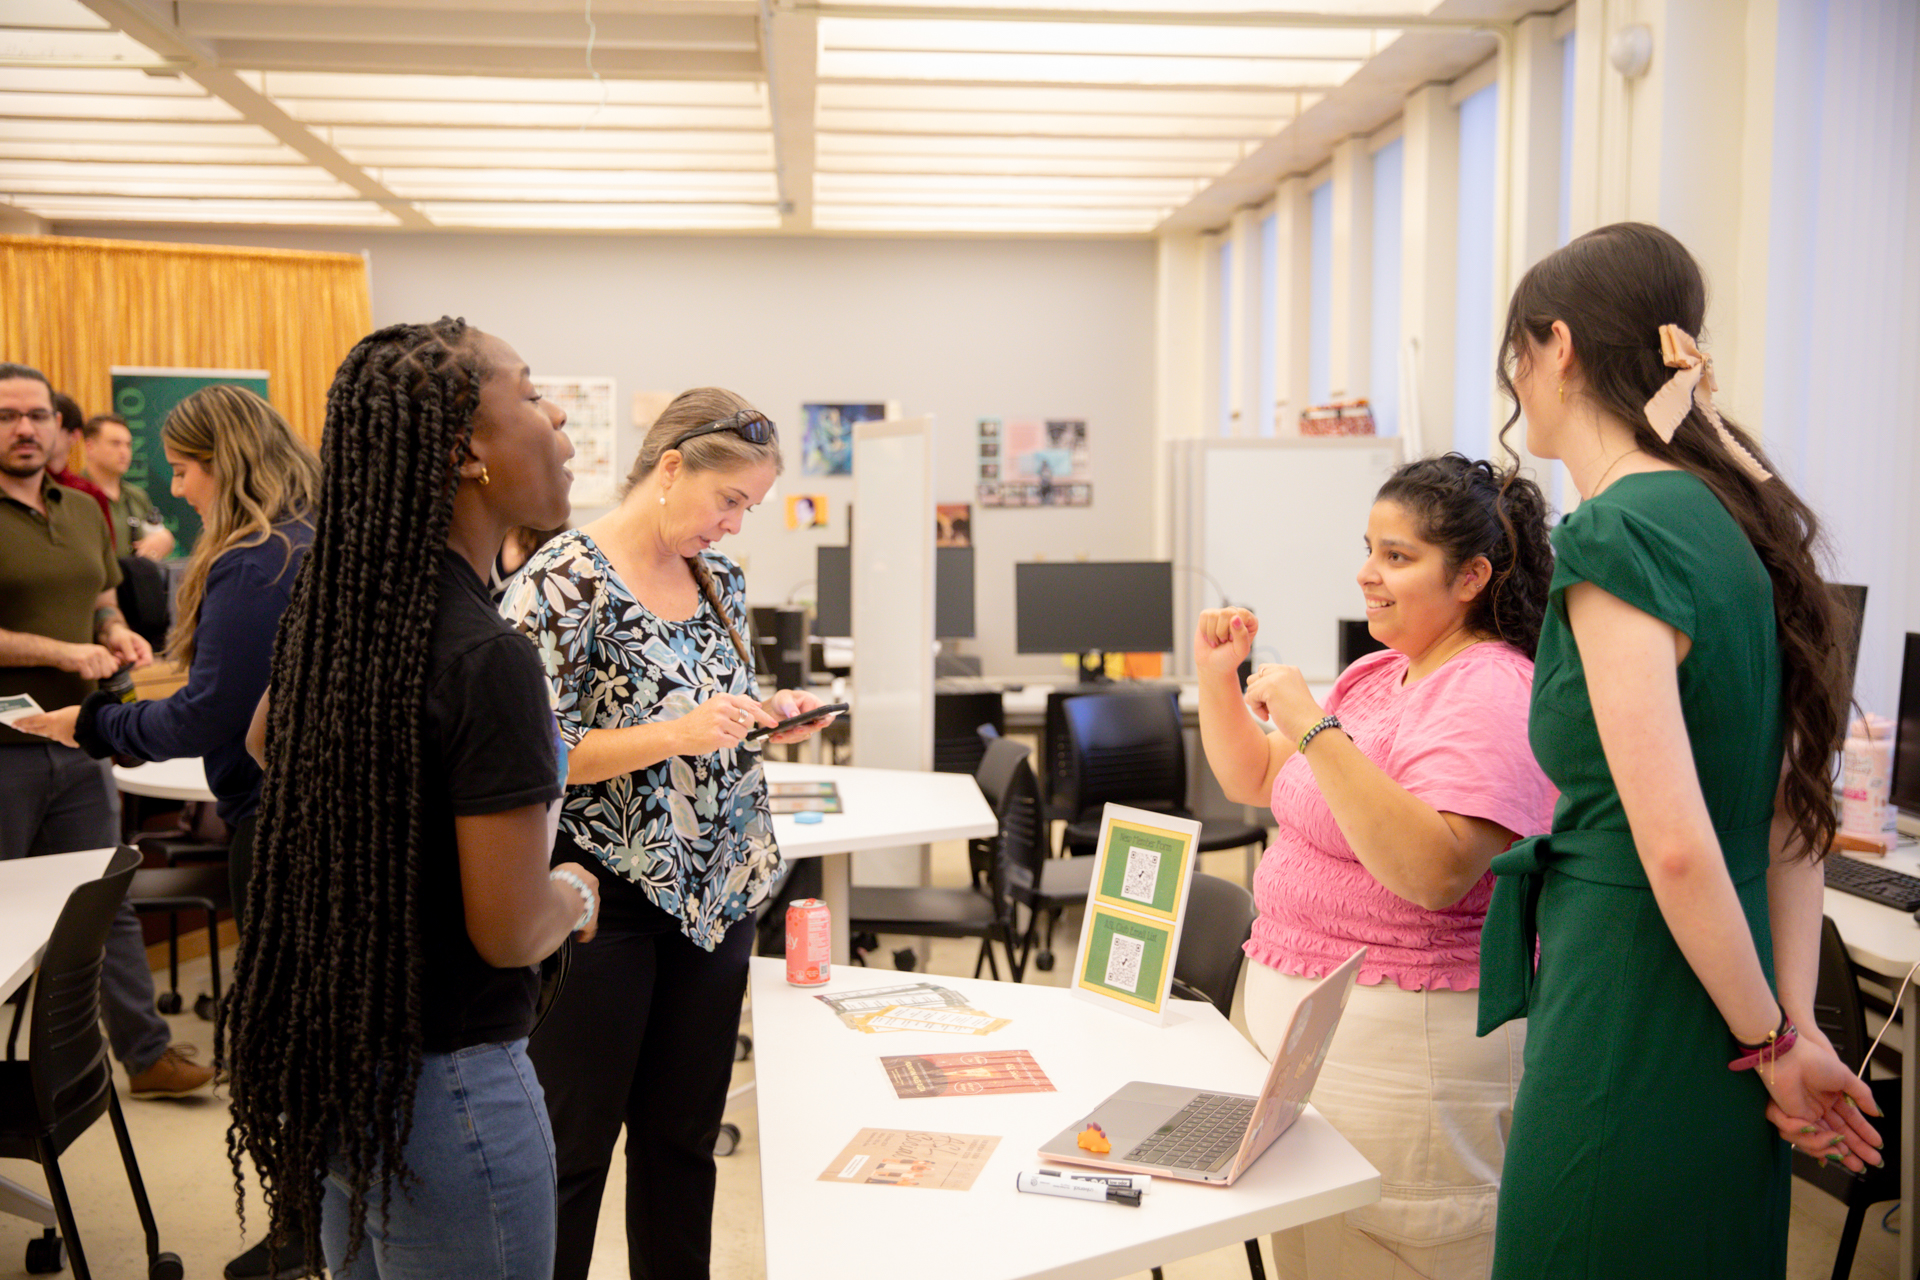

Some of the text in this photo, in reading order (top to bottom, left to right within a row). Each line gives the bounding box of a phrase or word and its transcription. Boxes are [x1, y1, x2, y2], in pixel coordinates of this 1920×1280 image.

[1120, 833, 1172, 852] New Member Form
[1104, 920, 1157, 942] ASL Club Email List
[891, 1132, 933, 1160] Social
